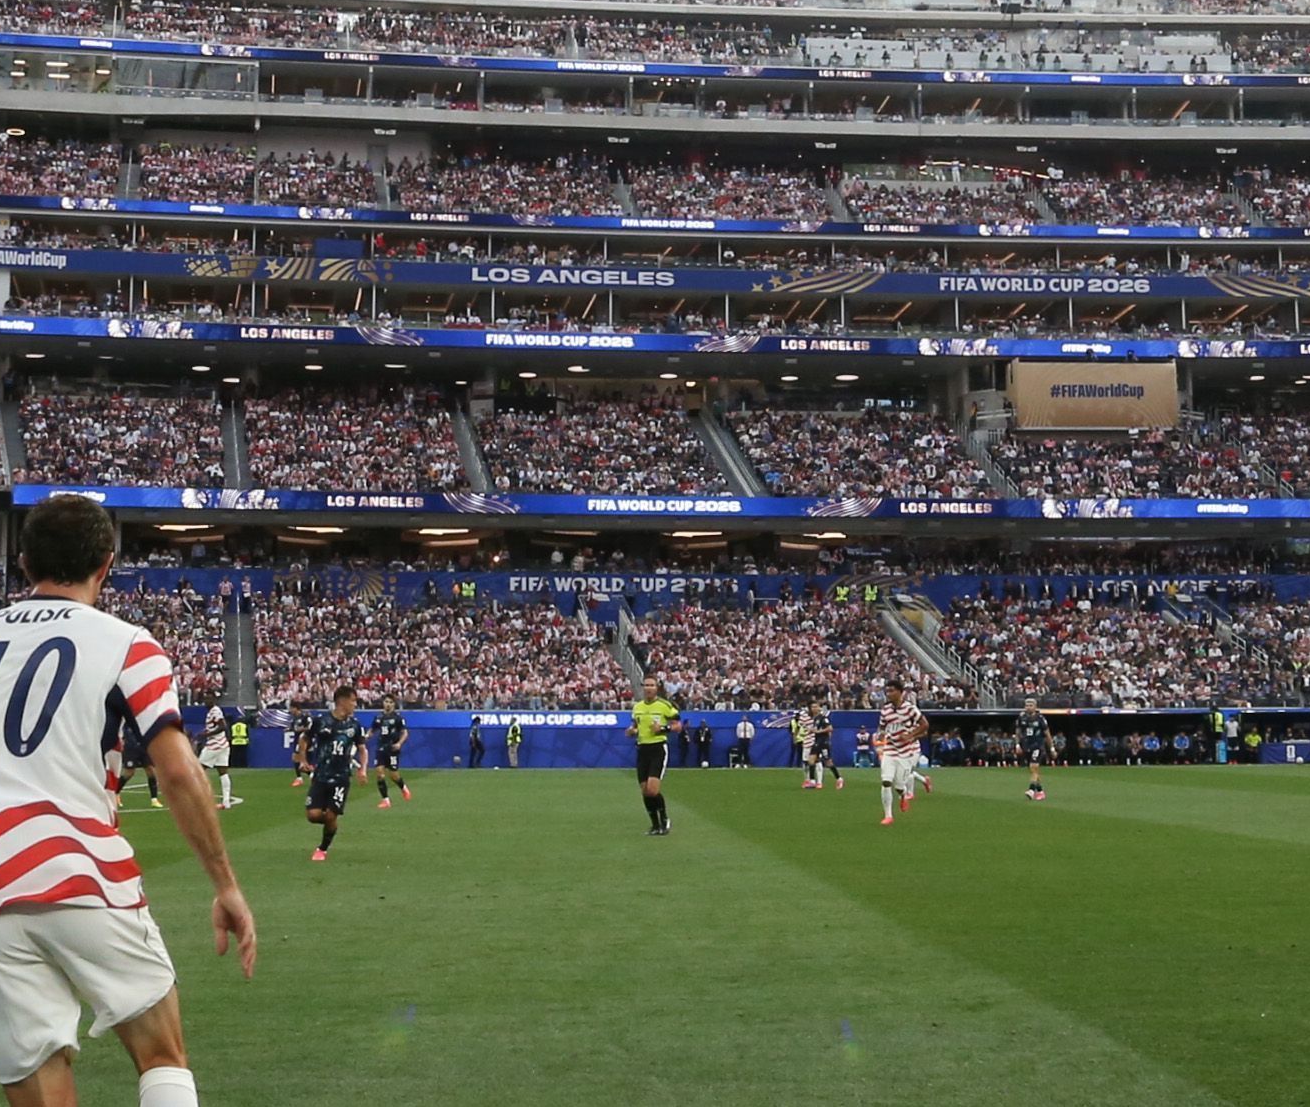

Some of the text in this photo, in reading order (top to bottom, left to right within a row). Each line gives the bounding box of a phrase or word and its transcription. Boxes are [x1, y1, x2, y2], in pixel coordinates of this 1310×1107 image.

[472, 267, 674, 286] LOS ANGELES
[939, 277, 1149, 293] FIFA WORLD CUP 2026
[241, 327, 334, 340] LOS ANGELES
[486, 334, 634, 348] FIFA WORLD CUP 2026
[781, 339, 870, 351] LOS ANGELES
[1050, 384, 1144, 399] #FIFAWorldCup
[327, 496, 424, 508] LOS ANGELES
[588, 500, 741, 512] FIFA WORLD CUP 2026
[900, 502, 992, 513] LOS ANGELES
[554, 577, 624, 592] WORLD
[547, 714, 572, 726] CUP
[573, 714, 617, 726] 2026
[332, 741, 343, 755] 14
[333, 787, 345, 801] 14
